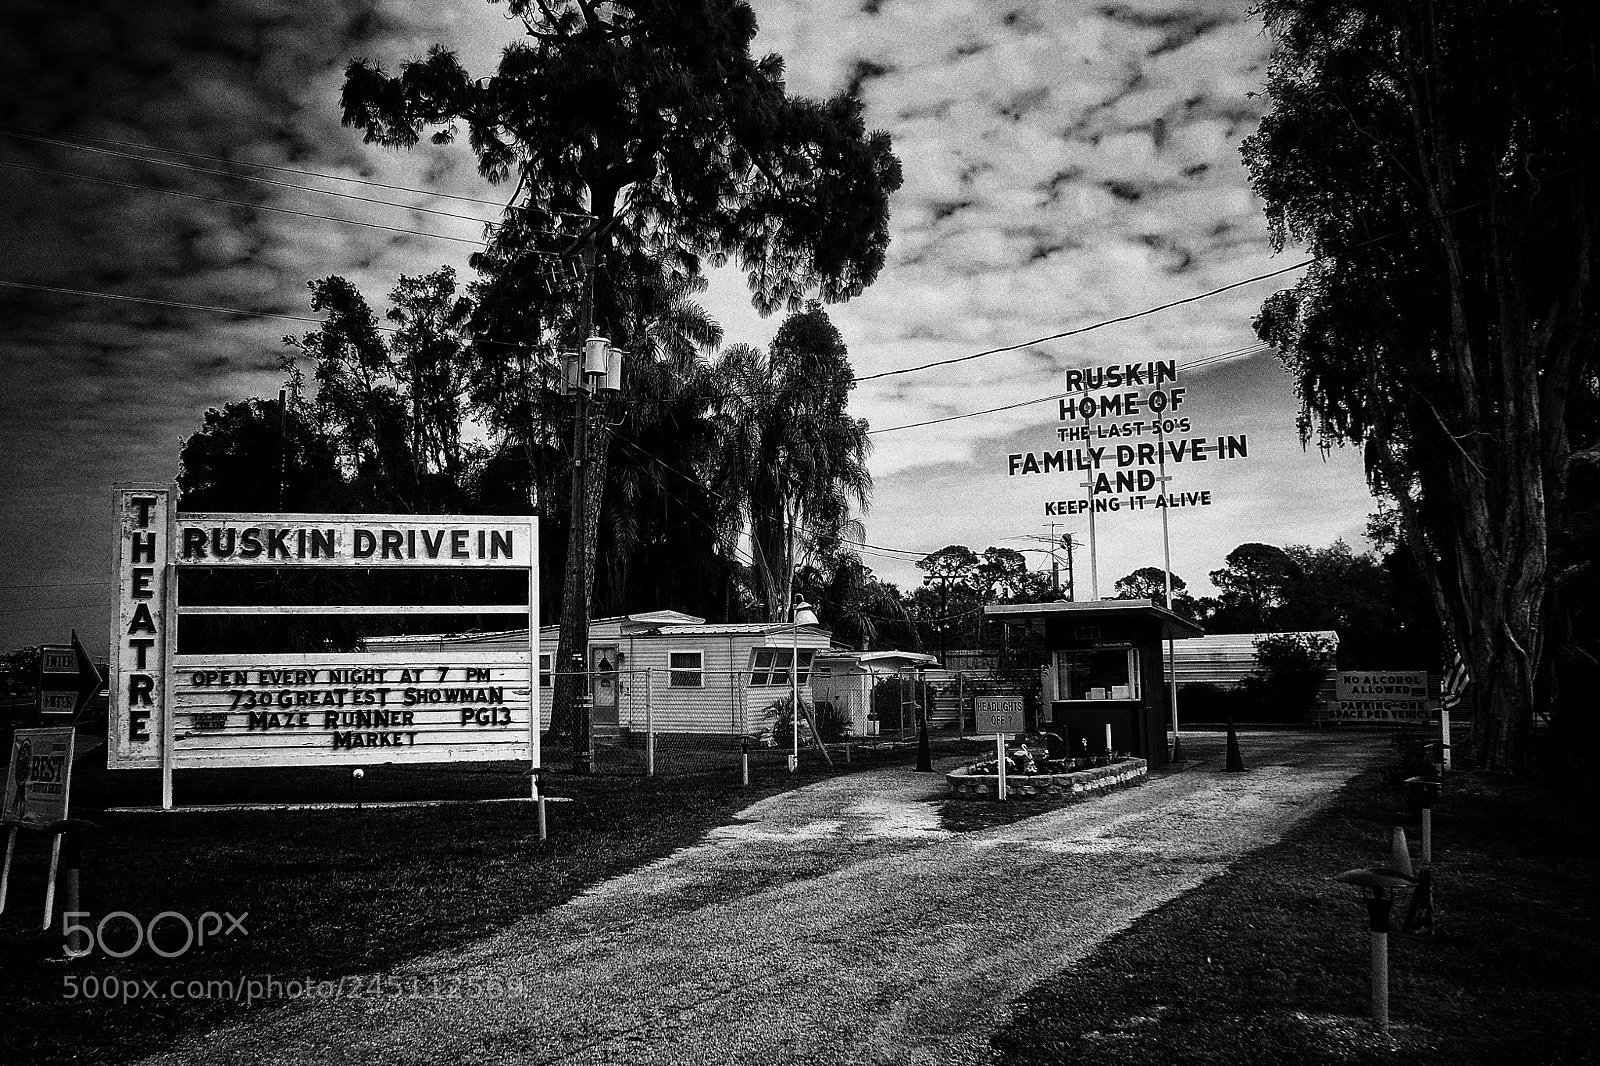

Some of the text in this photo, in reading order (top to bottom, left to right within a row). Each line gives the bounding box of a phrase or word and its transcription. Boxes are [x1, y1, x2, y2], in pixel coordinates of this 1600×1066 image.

[1065, 360, 1177, 391] RUSKIN
[1059, 388, 1186, 420] HOME OF
[1057, 417, 1191, 442] THE LAST 50'S
[1008, 434, 1248, 476] FAMILY DRIVE IN
[1093, 469, 1156, 495] AND
[1045, 490, 1211, 516] KEEPING IT ALIVE
[183, 527, 336, 559] RUSKIN
[128, 496, 157, 742] THEATRE
[46, 654, 74, 667] ENTER
[192, 667, 491, 686] OPEN EVERY NIGHT AT 7 PM
[1344, 675, 1421, 685] NO ALCOHOL
[277, 688, 390, 708] GREATEST
[403, 686, 503, 706] SHOWMAN
[1352, 685, 1410, 694] ALLOWED
[45, 695, 73, 708] ENTER
[977, 701, 1023, 712] HEADLIGHTS
[249, 707, 511, 730] MAZE RUNNER PG13
[991, 715, 1005, 725] OFF
[1328, 710, 1364, 719] SPACE
[1366, 710, 1388, 719] PER
[333, 731, 418, 750] MARKET
[30, 755, 65, 782] BEST
